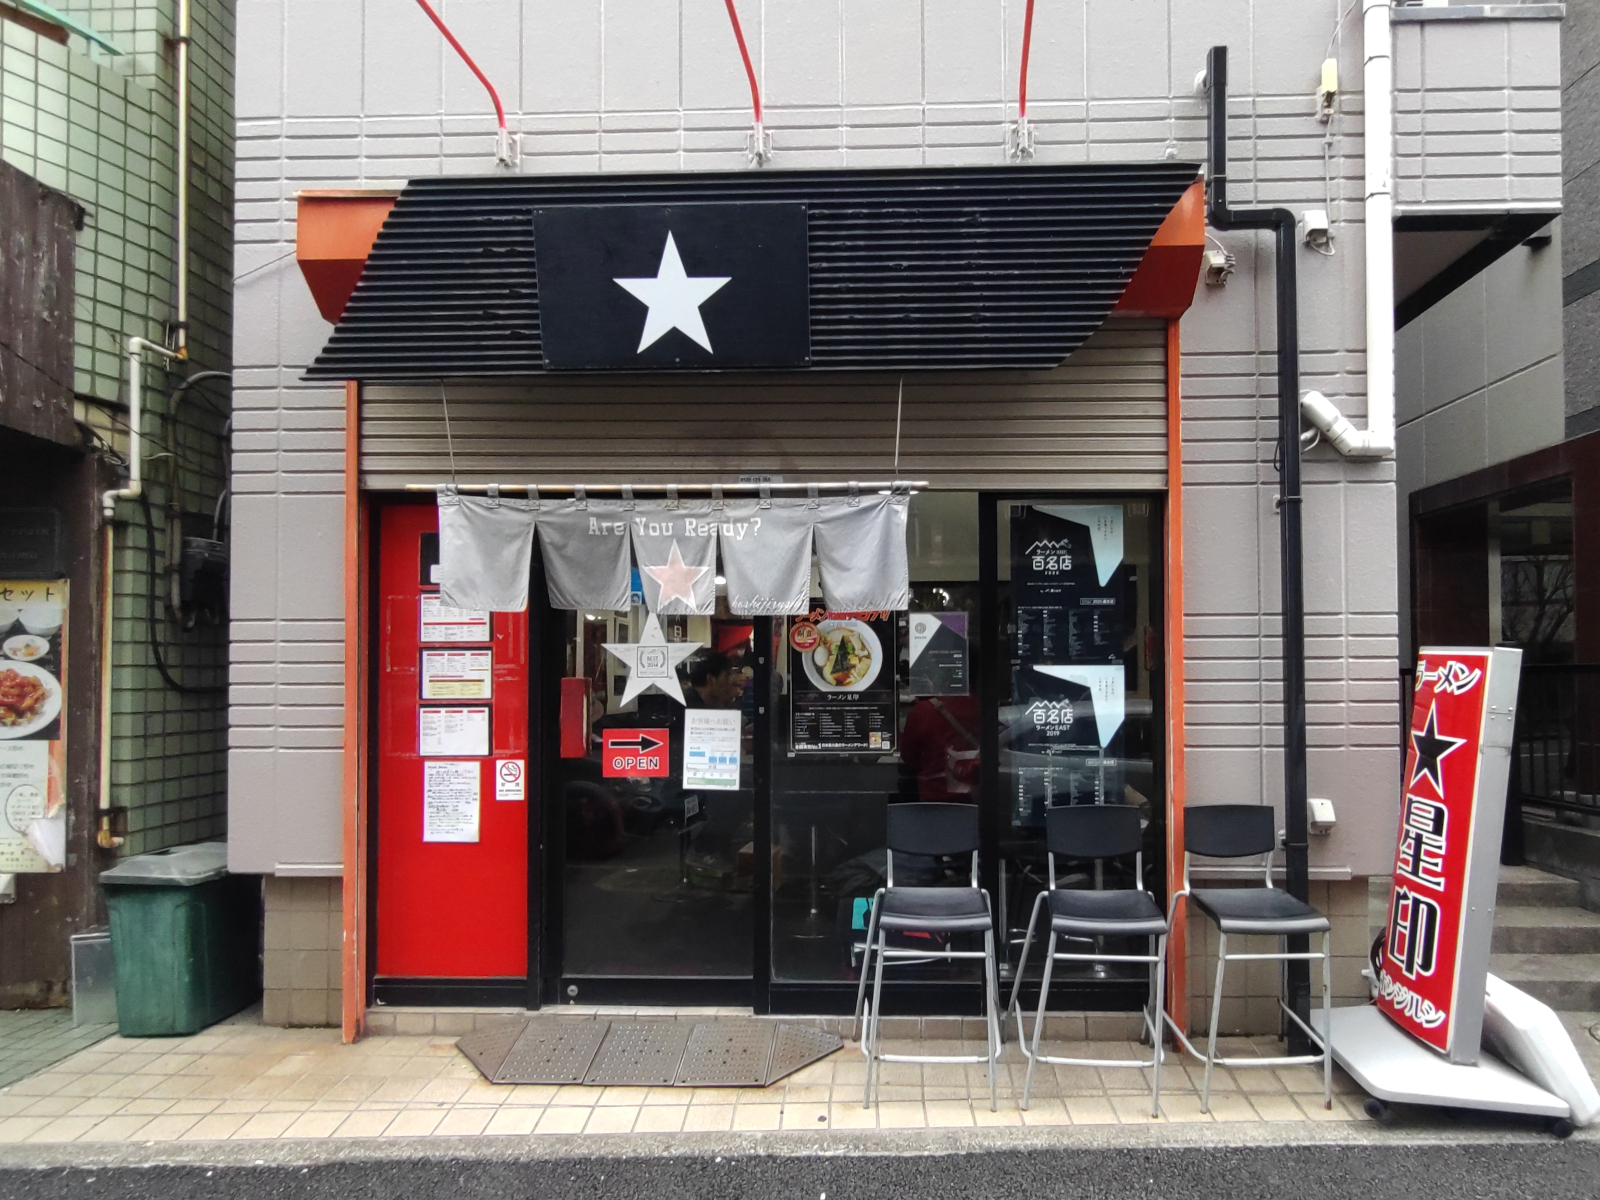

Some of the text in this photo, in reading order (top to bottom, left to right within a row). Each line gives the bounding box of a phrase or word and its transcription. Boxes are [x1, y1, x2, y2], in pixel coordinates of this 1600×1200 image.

[588, 517, 762, 540] Are You Ready?
[1031, 555, 1072, 570] 百名店
[1415, 660, 1482, 696] ラーメン
[827, 693, 847, 701] ラーメン
[1032, 708, 1074, 724] 百名店
[612, 756, 660, 770] OPEN
[1388, 793, 1448, 981] 星印
